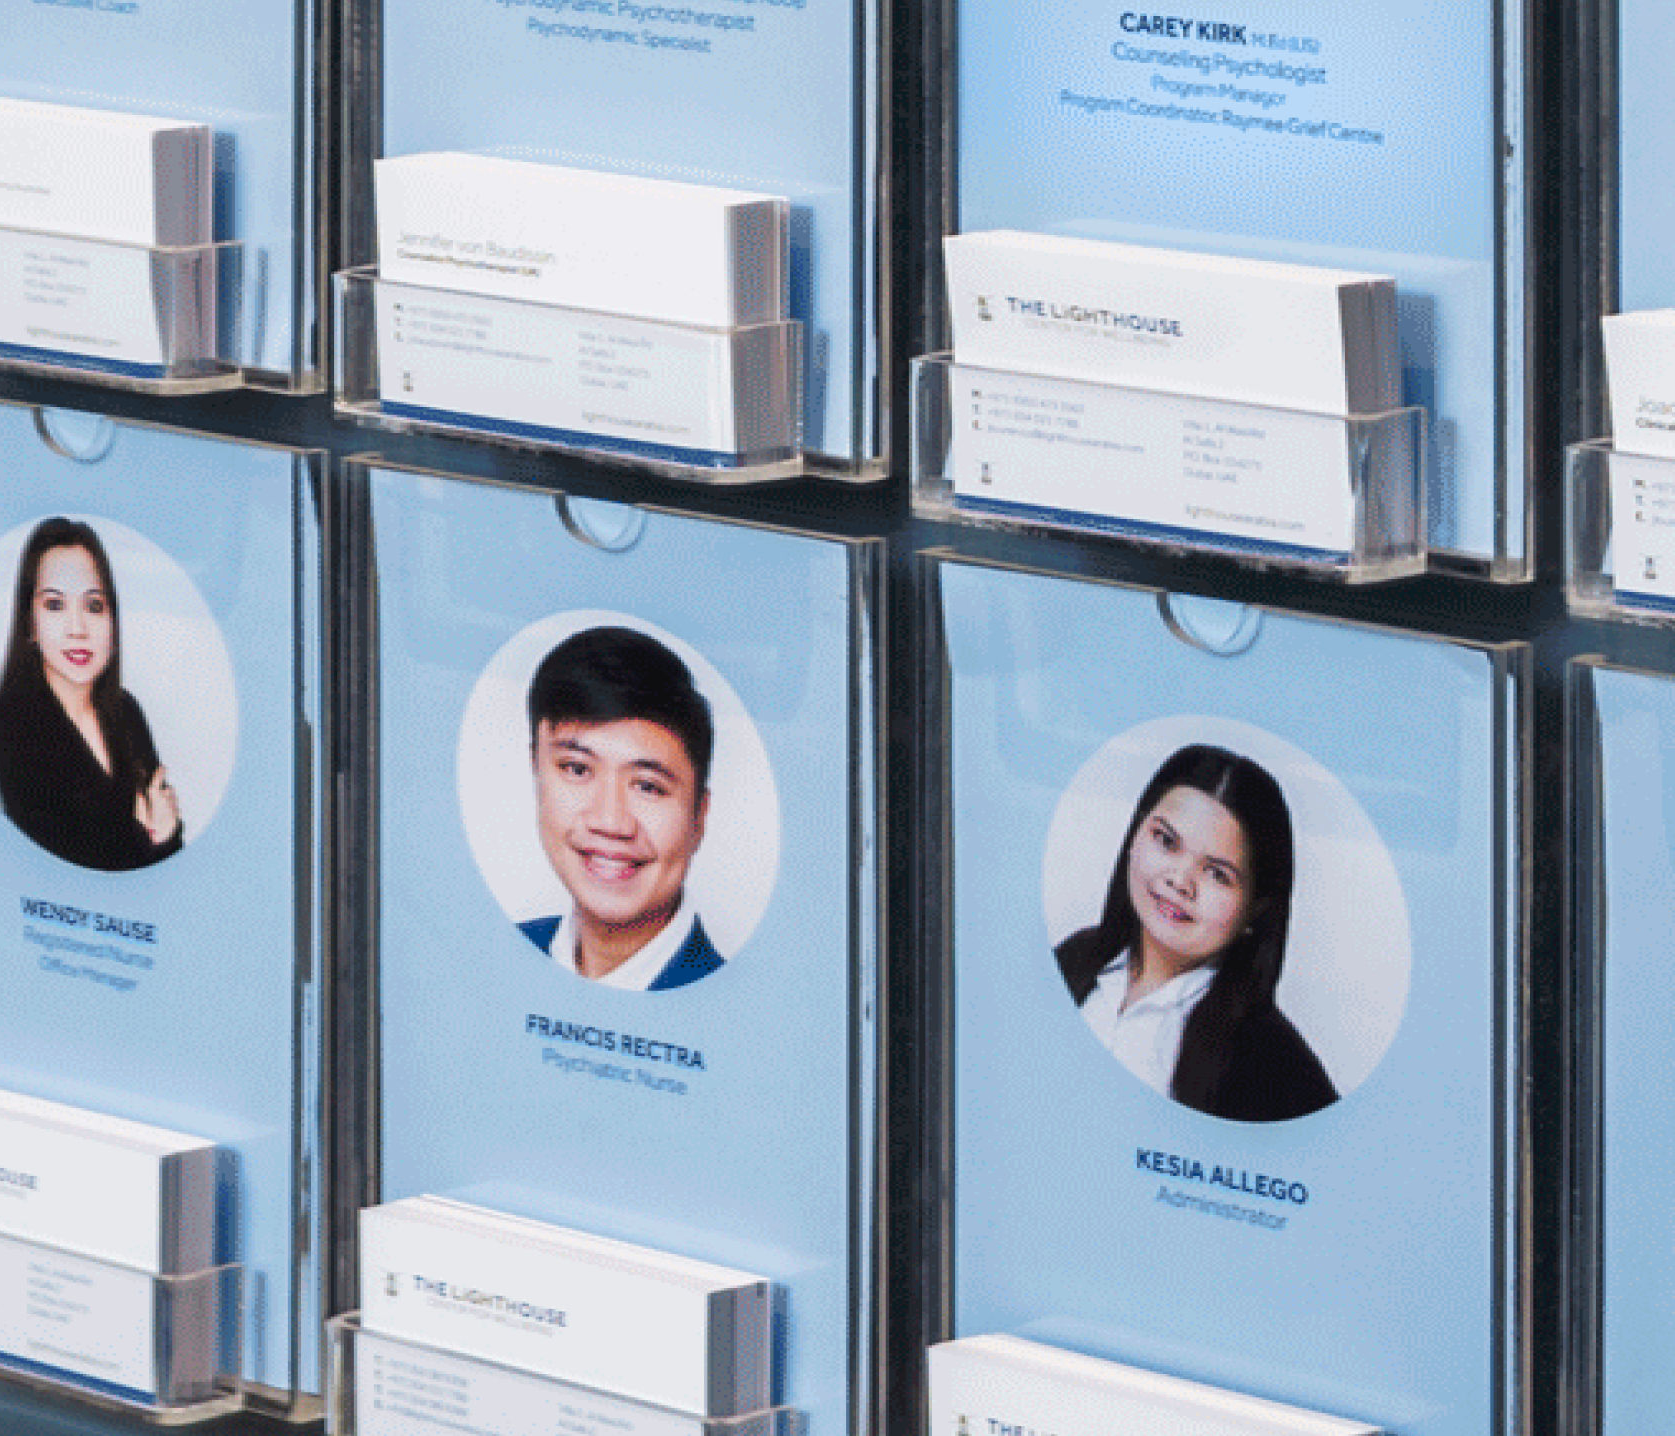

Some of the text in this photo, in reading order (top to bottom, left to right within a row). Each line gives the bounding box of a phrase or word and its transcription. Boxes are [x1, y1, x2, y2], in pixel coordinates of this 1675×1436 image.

[526, 16, 711, 52] Psychodynamic Specialist
[1118, 11, 1193, 38] CAREY
[1195, 19, 1247, 45] KIRK
[1150, 72, 1286, 109] Program Manager
[1212, 51, 1326, 86] Psychologist
[1060, 88, 1125, 114] Program
[1287, 116, 1327, 137] Grief
[1328, 122, 1385, 146] Centre
[1005, 296, 1047, 317] THE
[1051, 303, 1184, 337] LIGHTHOUSE
[20, 896, 158, 944] WENDY SAUSE
[525, 1013, 708, 1072] FRANCIS RECTRA
[542, 1047, 688, 1096] Psychiatric Nurse
[1136, 1146, 1309, 1206] KESIA ALLEGO
[1156, 1184, 1289, 1231] Administrator
[413, 1274, 568, 1328] THE LIGHTHOUSE
